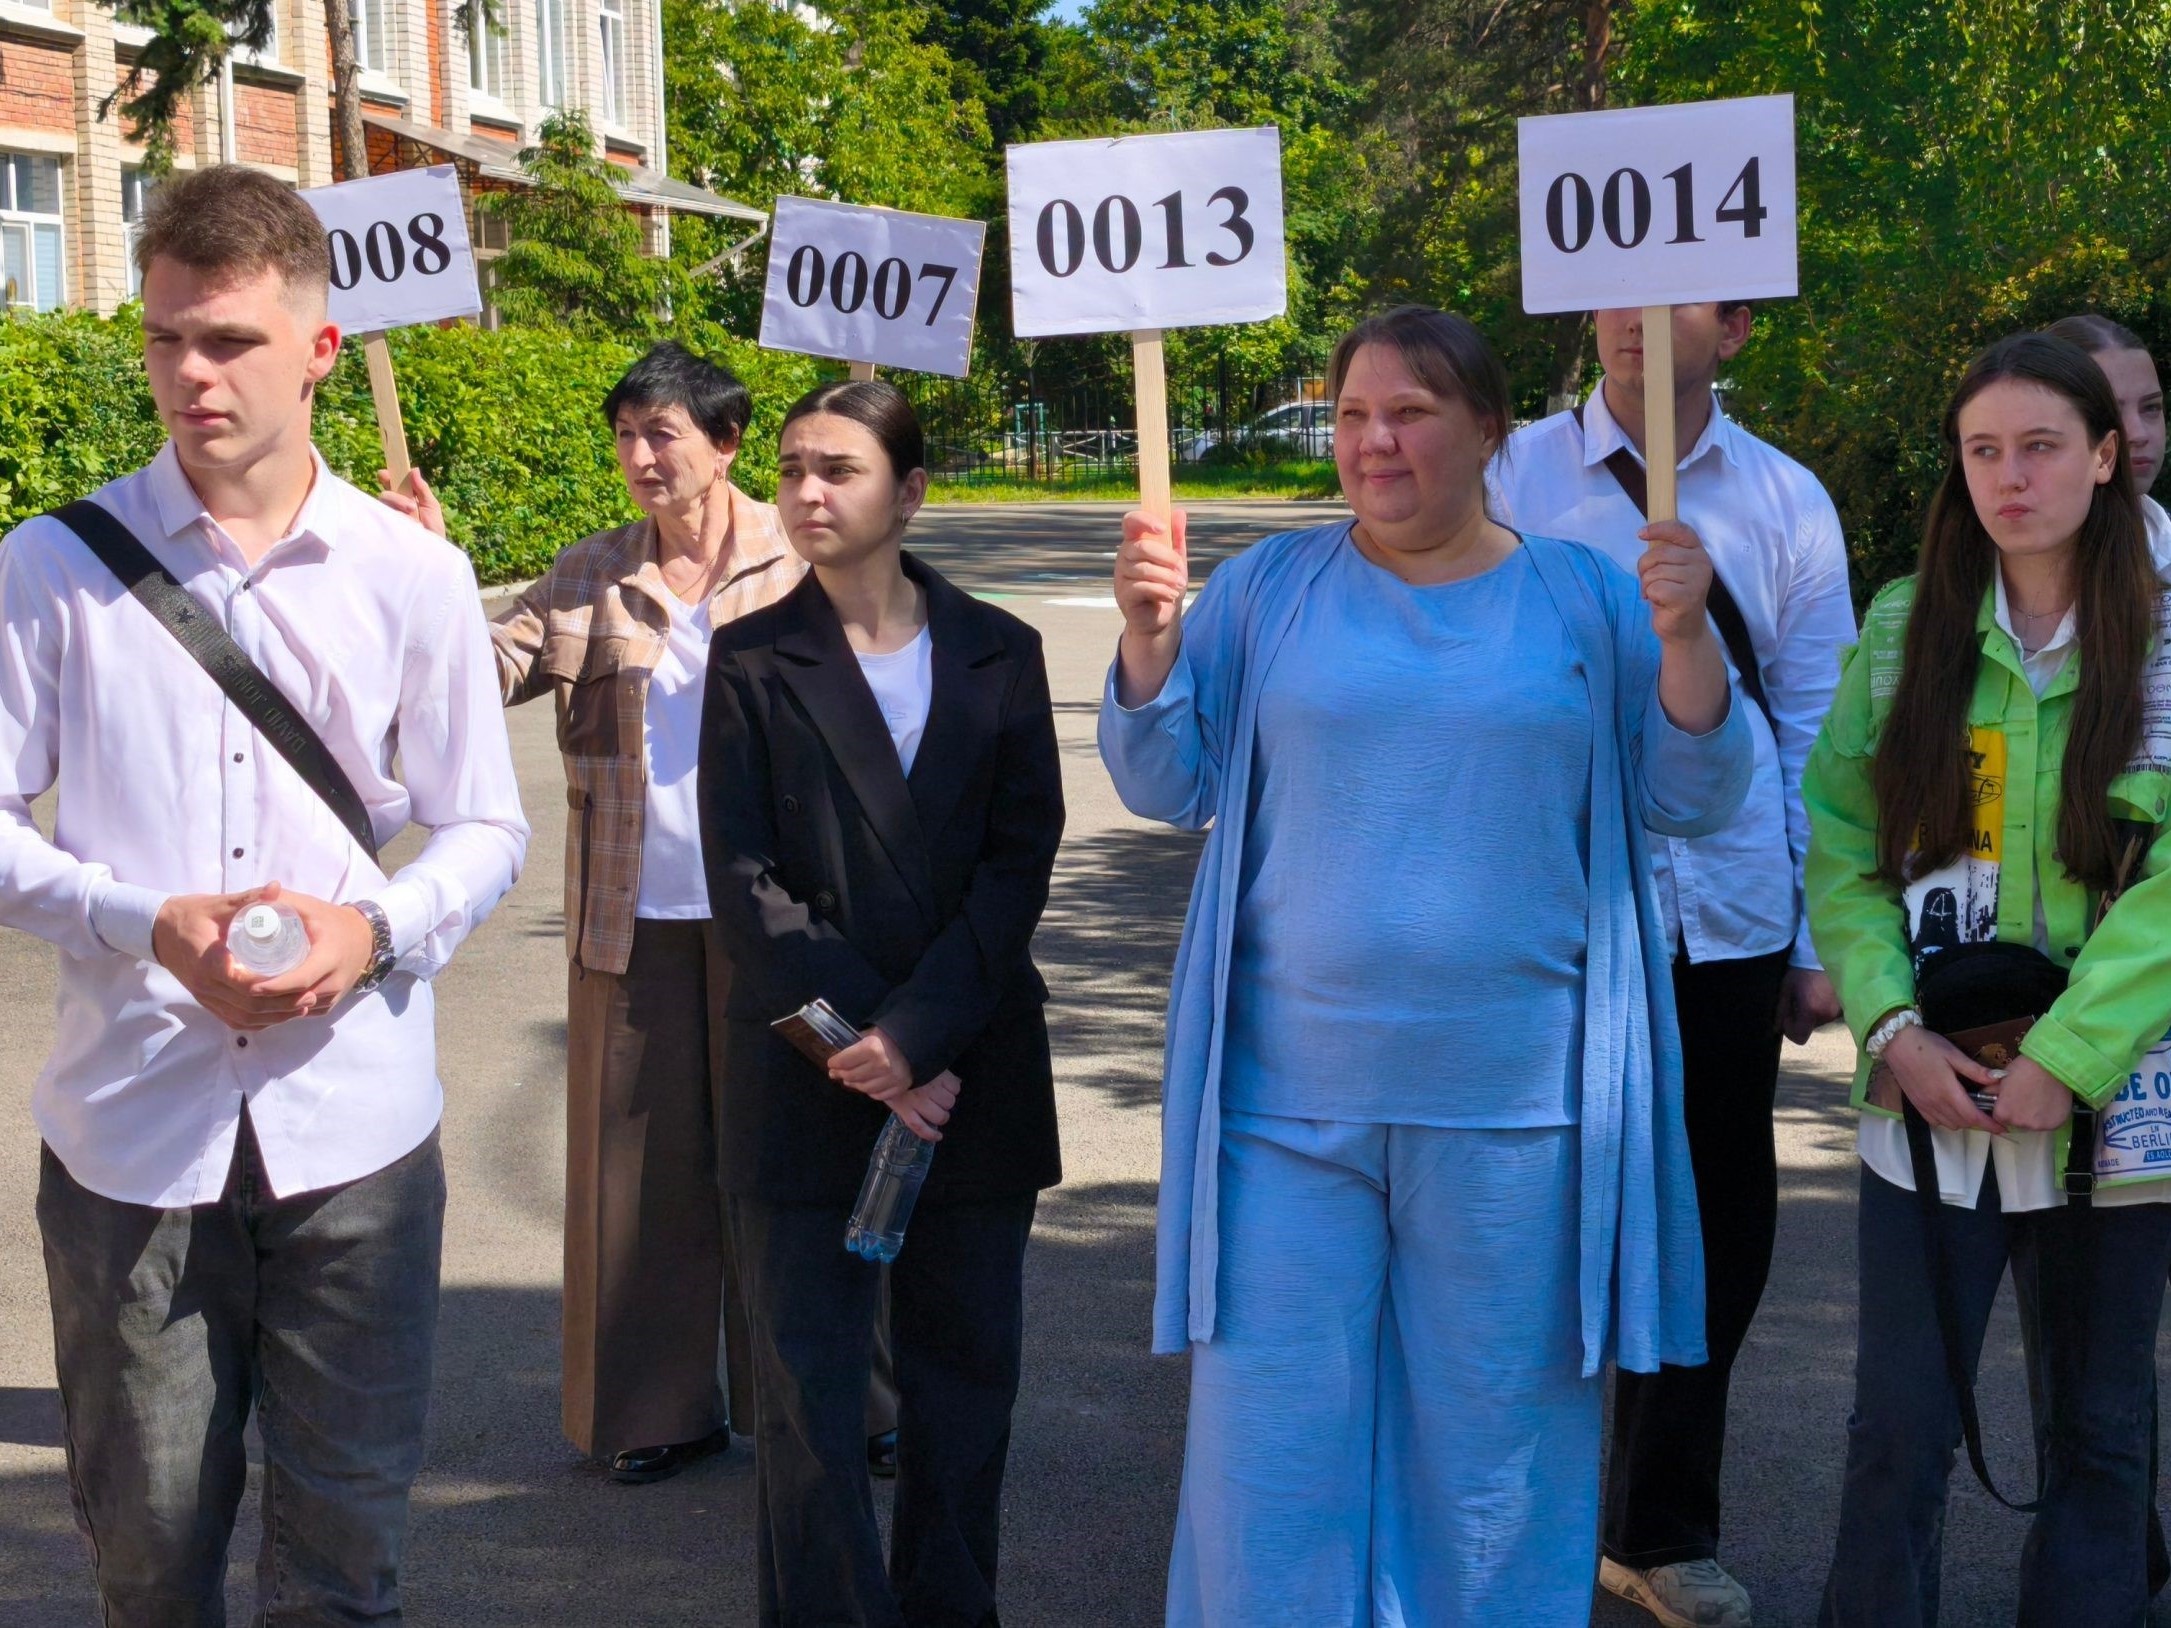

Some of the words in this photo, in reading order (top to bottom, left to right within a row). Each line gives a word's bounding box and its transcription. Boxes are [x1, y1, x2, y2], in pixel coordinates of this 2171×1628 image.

[1036, 186, 1254, 278] 0013
[1545, 156, 1768, 254] 0014
[328, 212, 451, 291] 008
[786, 244, 959, 327] 0007
[2131, 1132, 2171, 1149] BERLI
